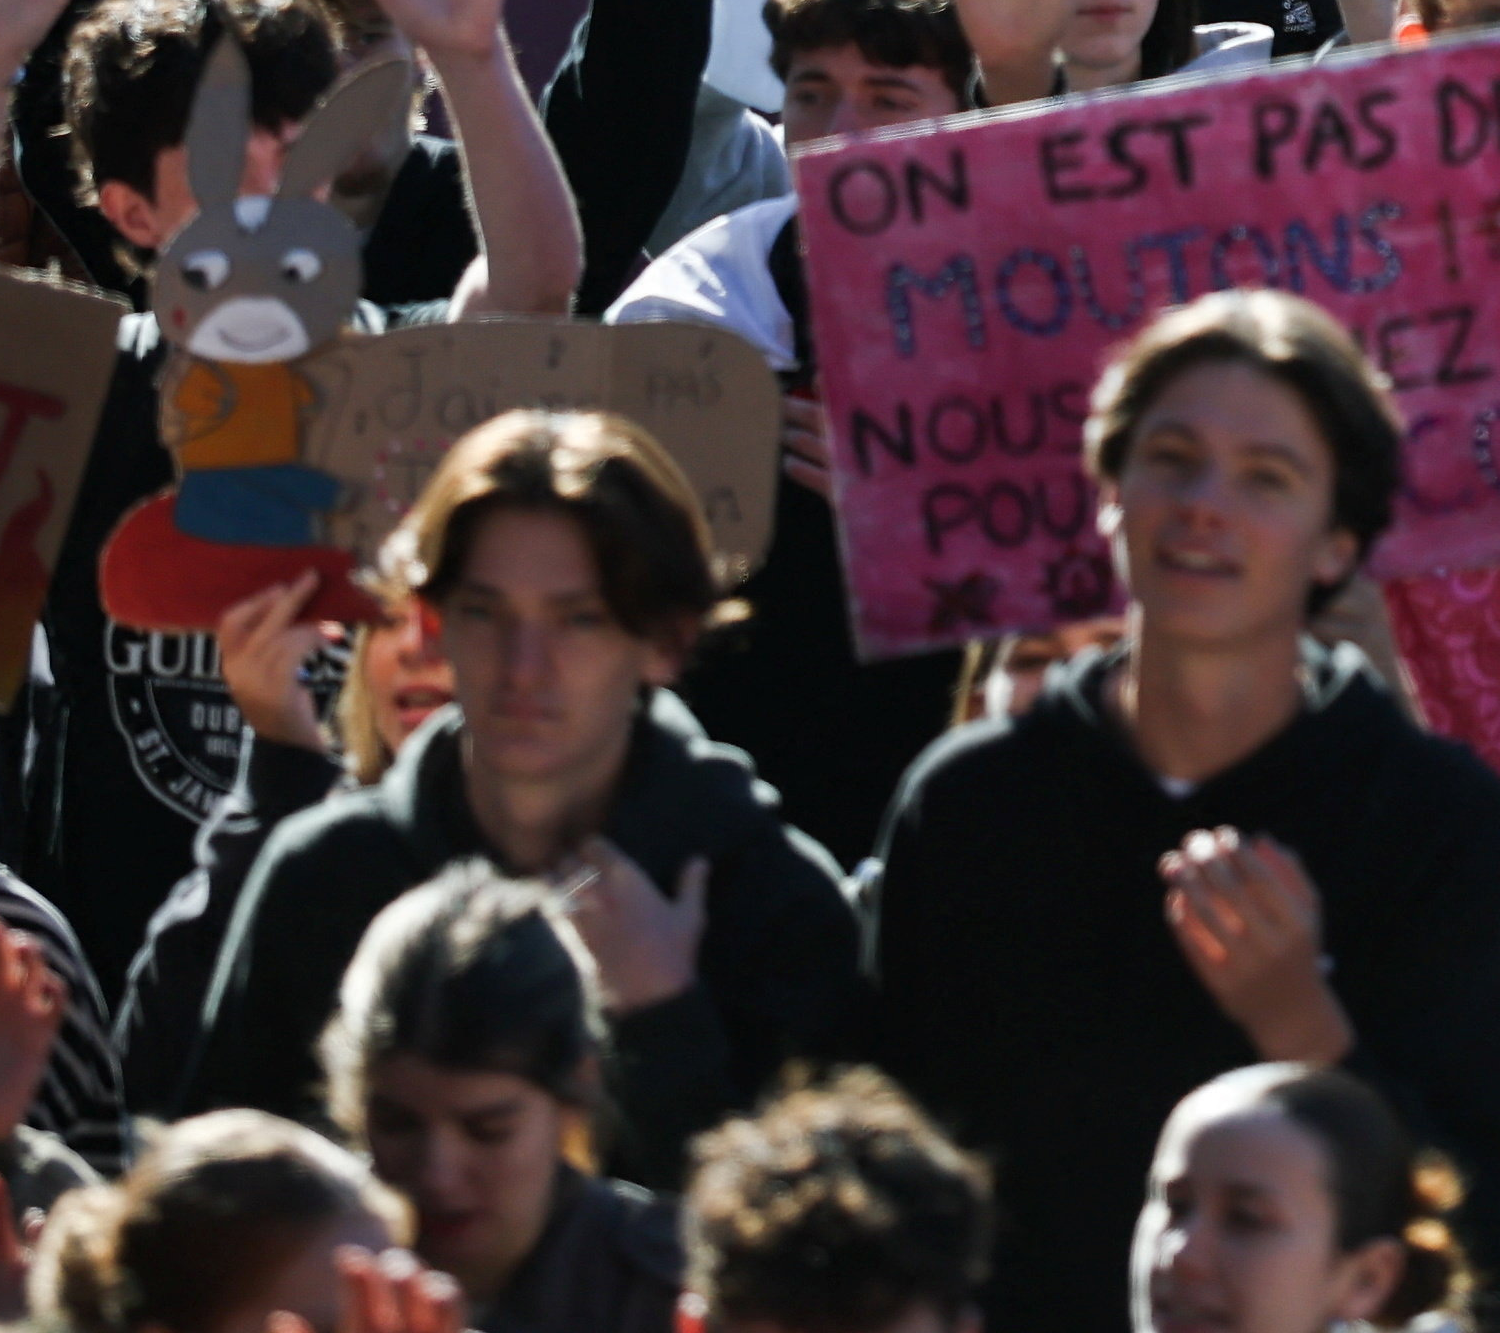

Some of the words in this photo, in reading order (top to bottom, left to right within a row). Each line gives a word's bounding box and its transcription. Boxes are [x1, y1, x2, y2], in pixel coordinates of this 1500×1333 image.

[825, 145, 972, 236] ON
[1039, 113, 1209, 205] EST
[1252, 89, 1402, 180] PAS
[885, 199, 1404, 356] MOUTONS
[850, 378, 1086, 478] NOUS
